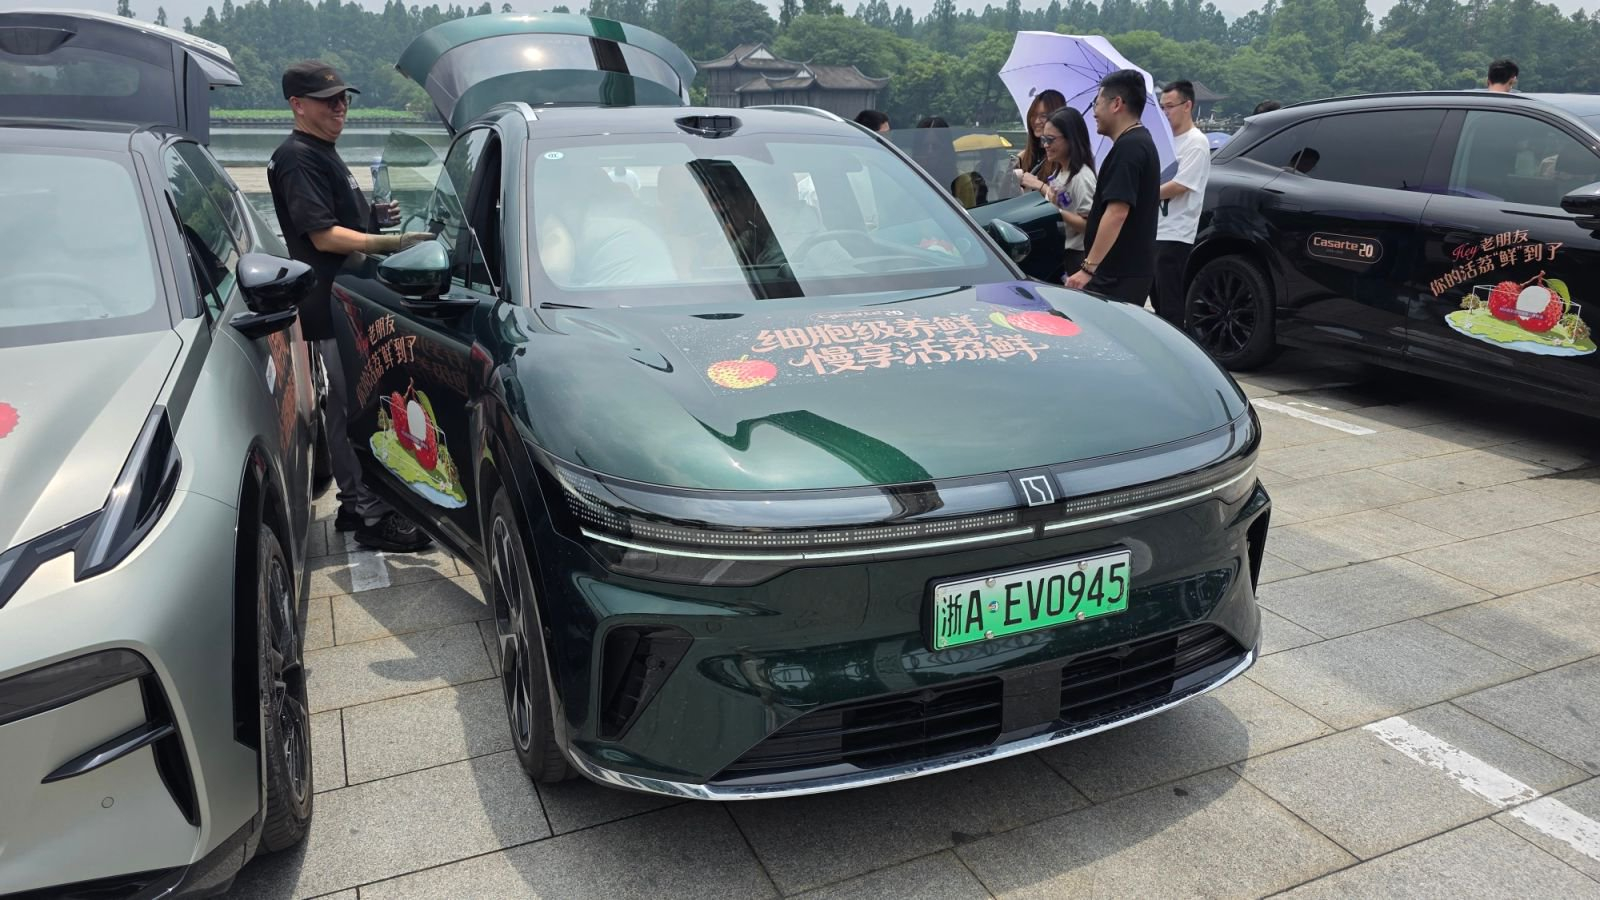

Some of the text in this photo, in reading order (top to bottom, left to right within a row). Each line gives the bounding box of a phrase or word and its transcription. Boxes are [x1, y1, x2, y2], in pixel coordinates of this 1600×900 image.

[1313, 237, 1374, 258] Casarte 20
[1480, 229, 1529, 252] 老朋友
[367, 313, 397, 346] 老朋友
[751, 315, 992, 353] 细胞级养鲜
[790, 334, 1050, 375] 慢享活荔鲜
